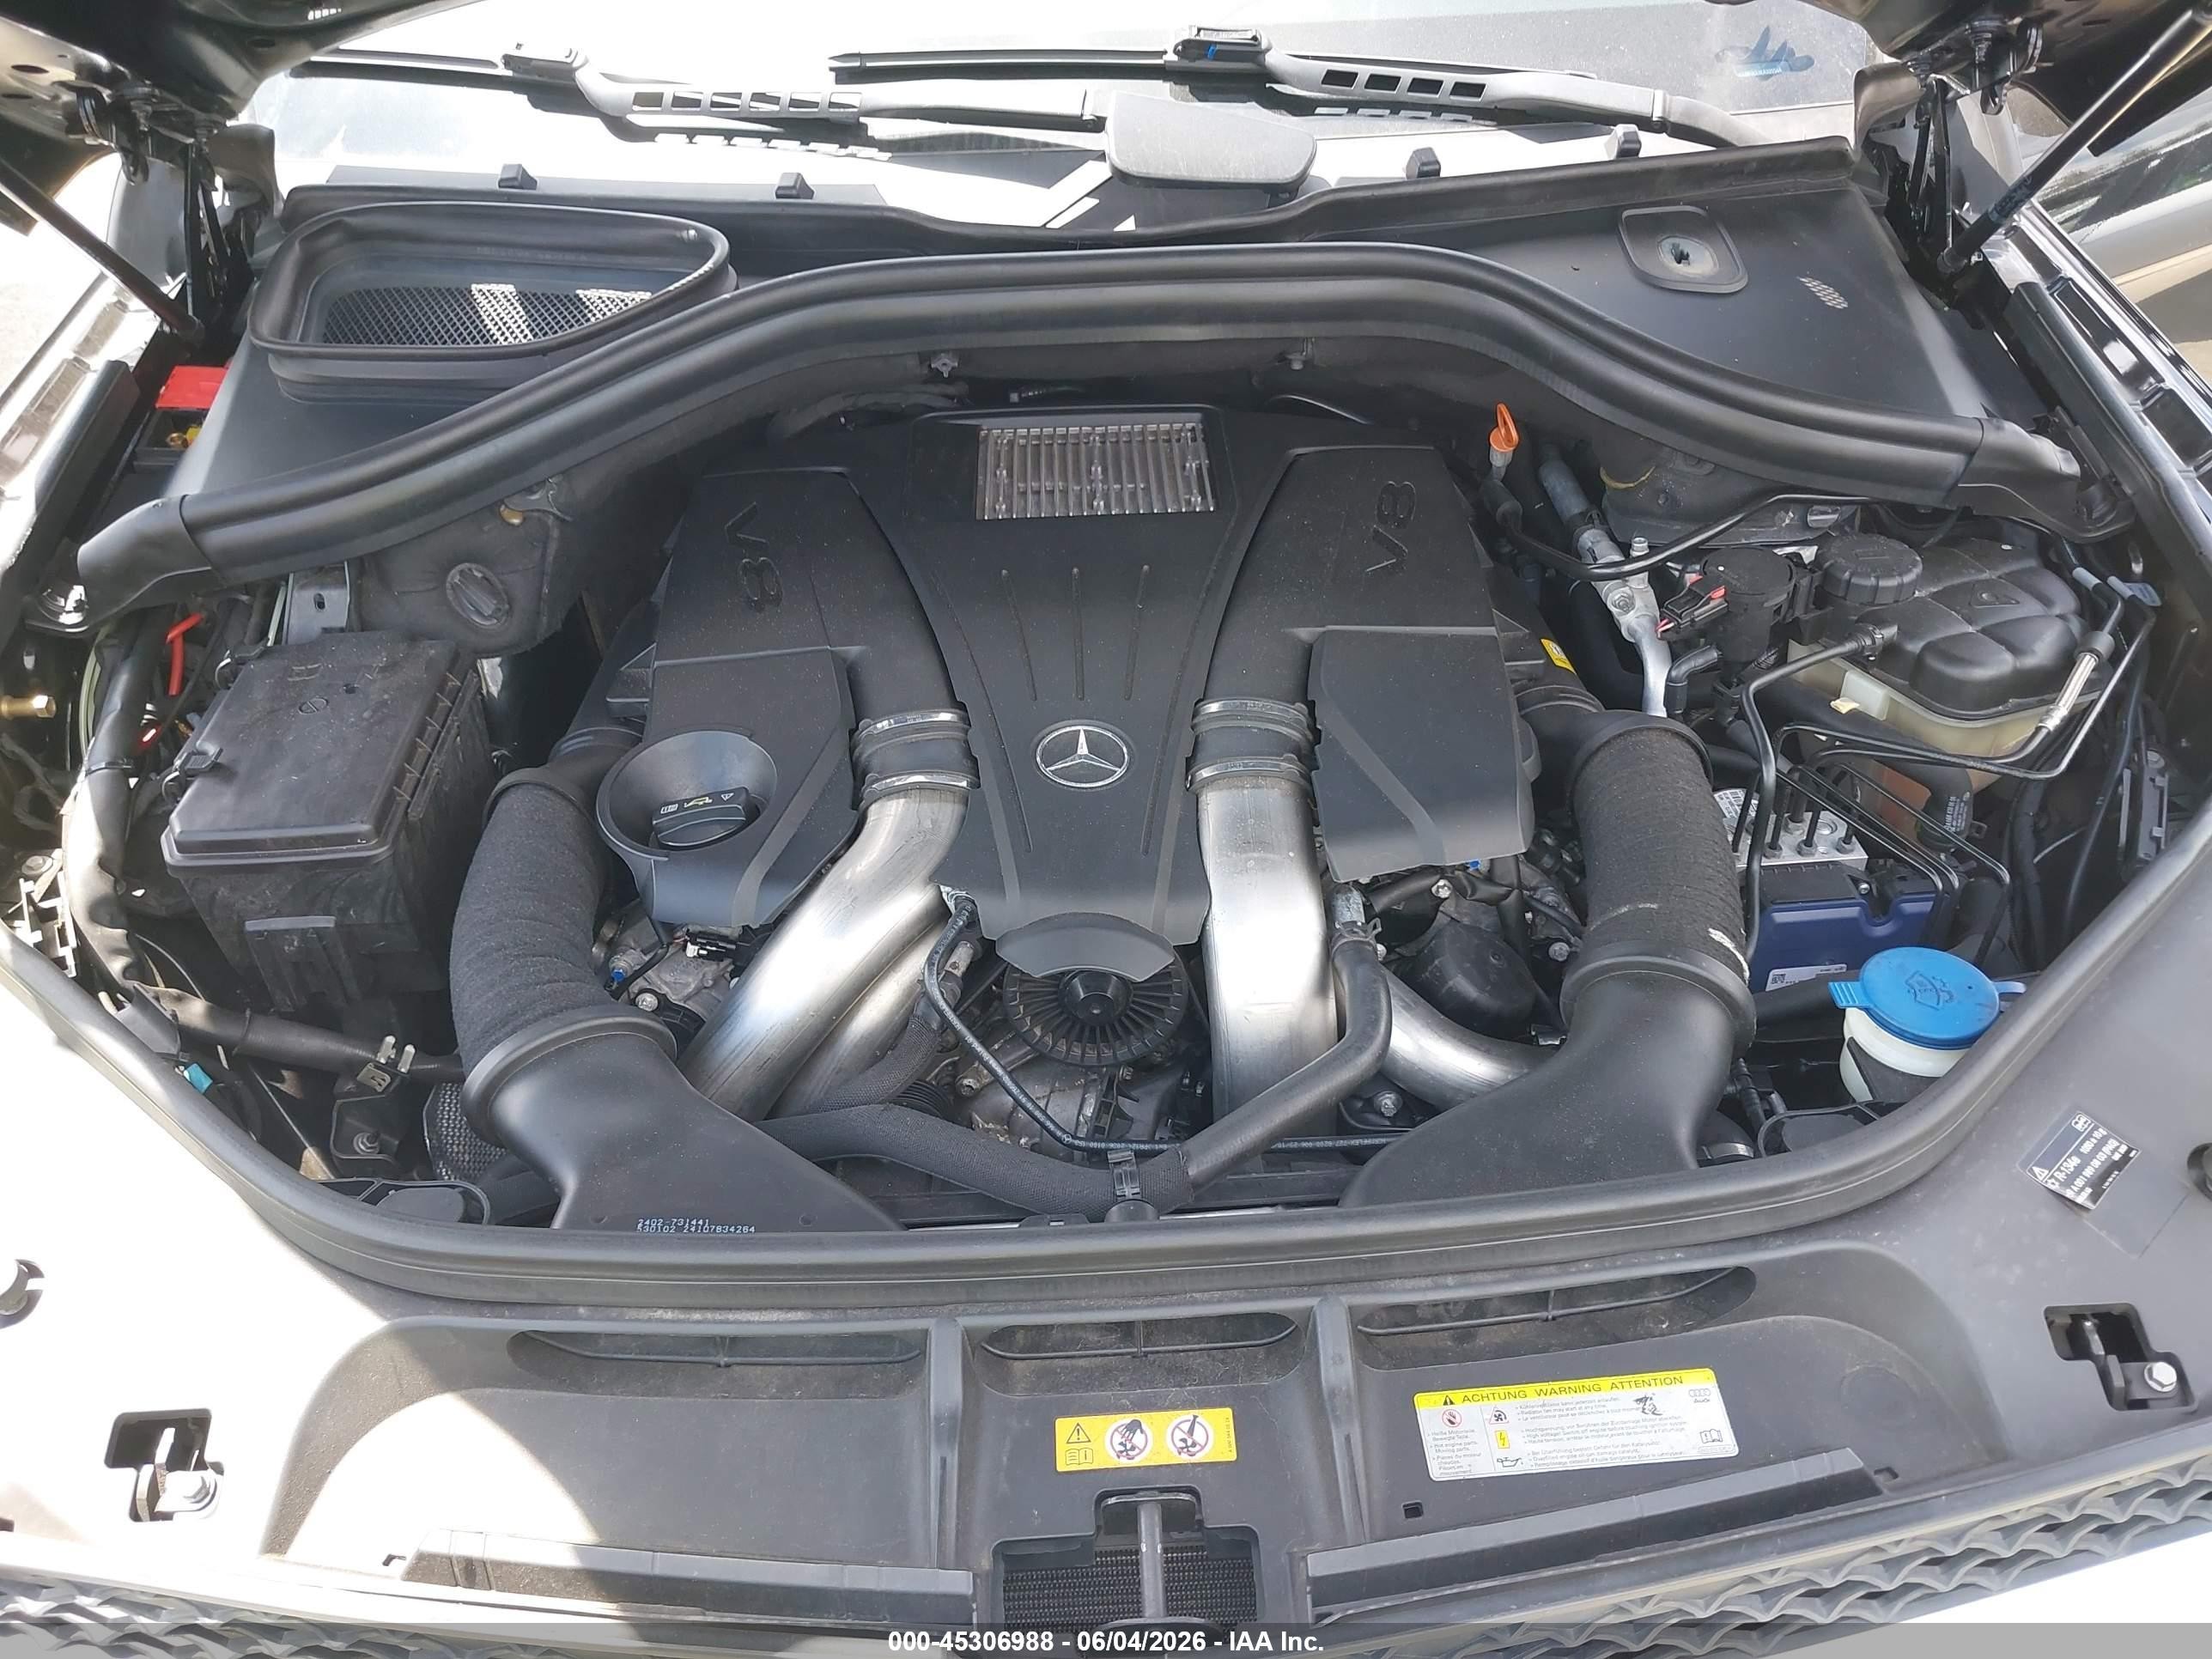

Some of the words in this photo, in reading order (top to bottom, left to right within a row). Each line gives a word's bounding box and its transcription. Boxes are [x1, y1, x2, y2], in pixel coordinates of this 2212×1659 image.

[1462, 1390, 1527, 1404] ACHTUNG
[1534, 1383, 1601, 1397] WARNING
[1610, 1376, 1683, 1390] ATTENTION
